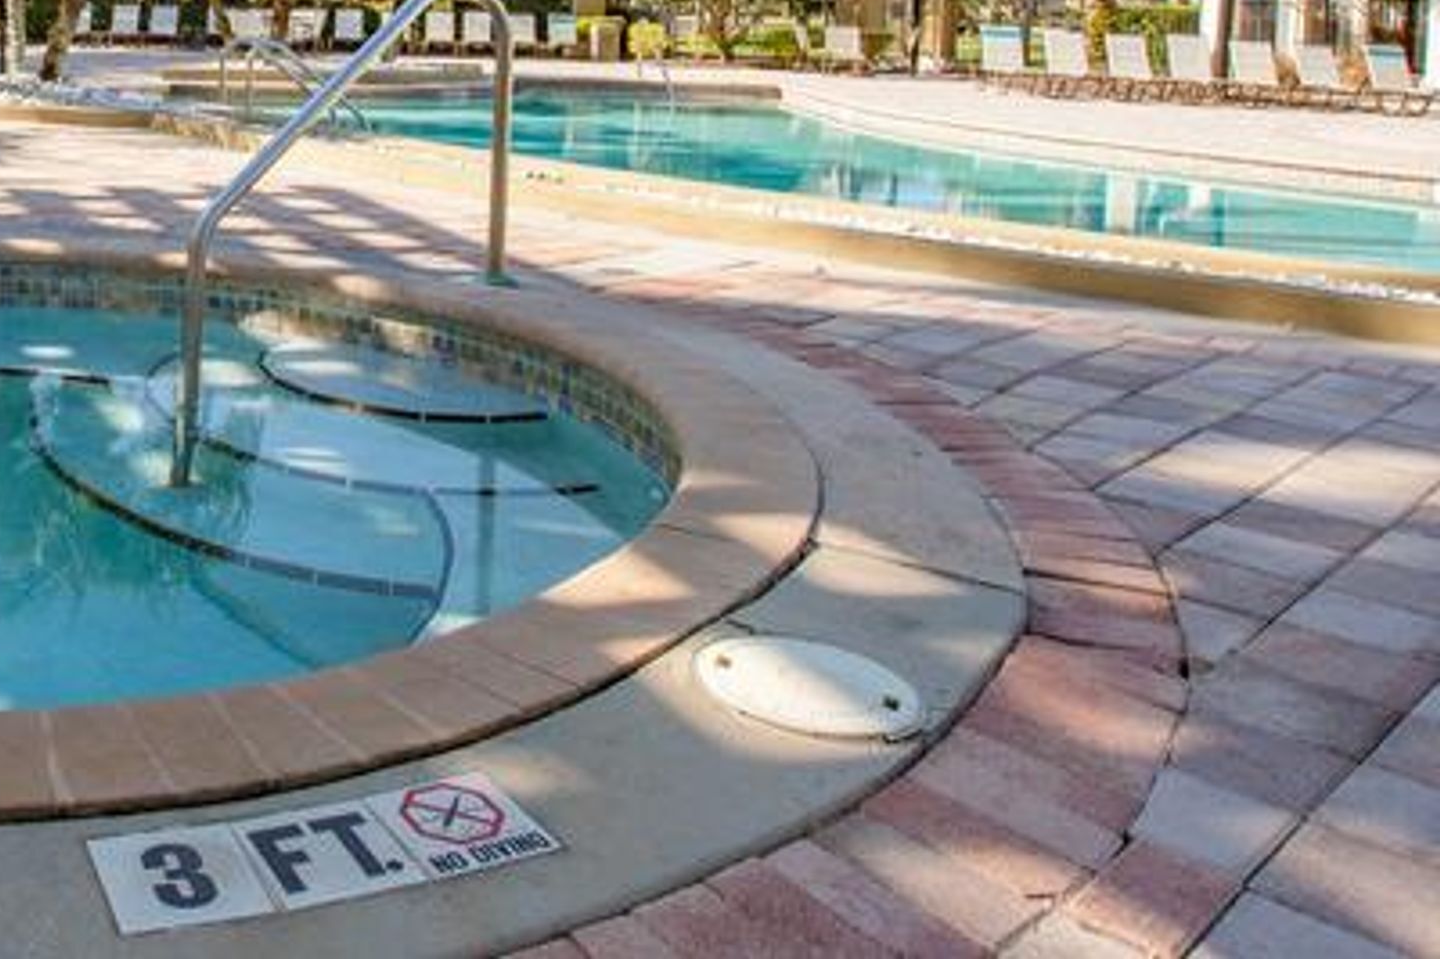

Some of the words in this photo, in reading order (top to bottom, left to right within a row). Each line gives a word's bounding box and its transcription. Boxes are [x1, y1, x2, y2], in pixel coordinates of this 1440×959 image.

[142, 843, 218, 908] 3
[248, 812, 403, 894] FT.
[428, 851, 469, 873] NO
[468, 831, 549, 863] DIVING
